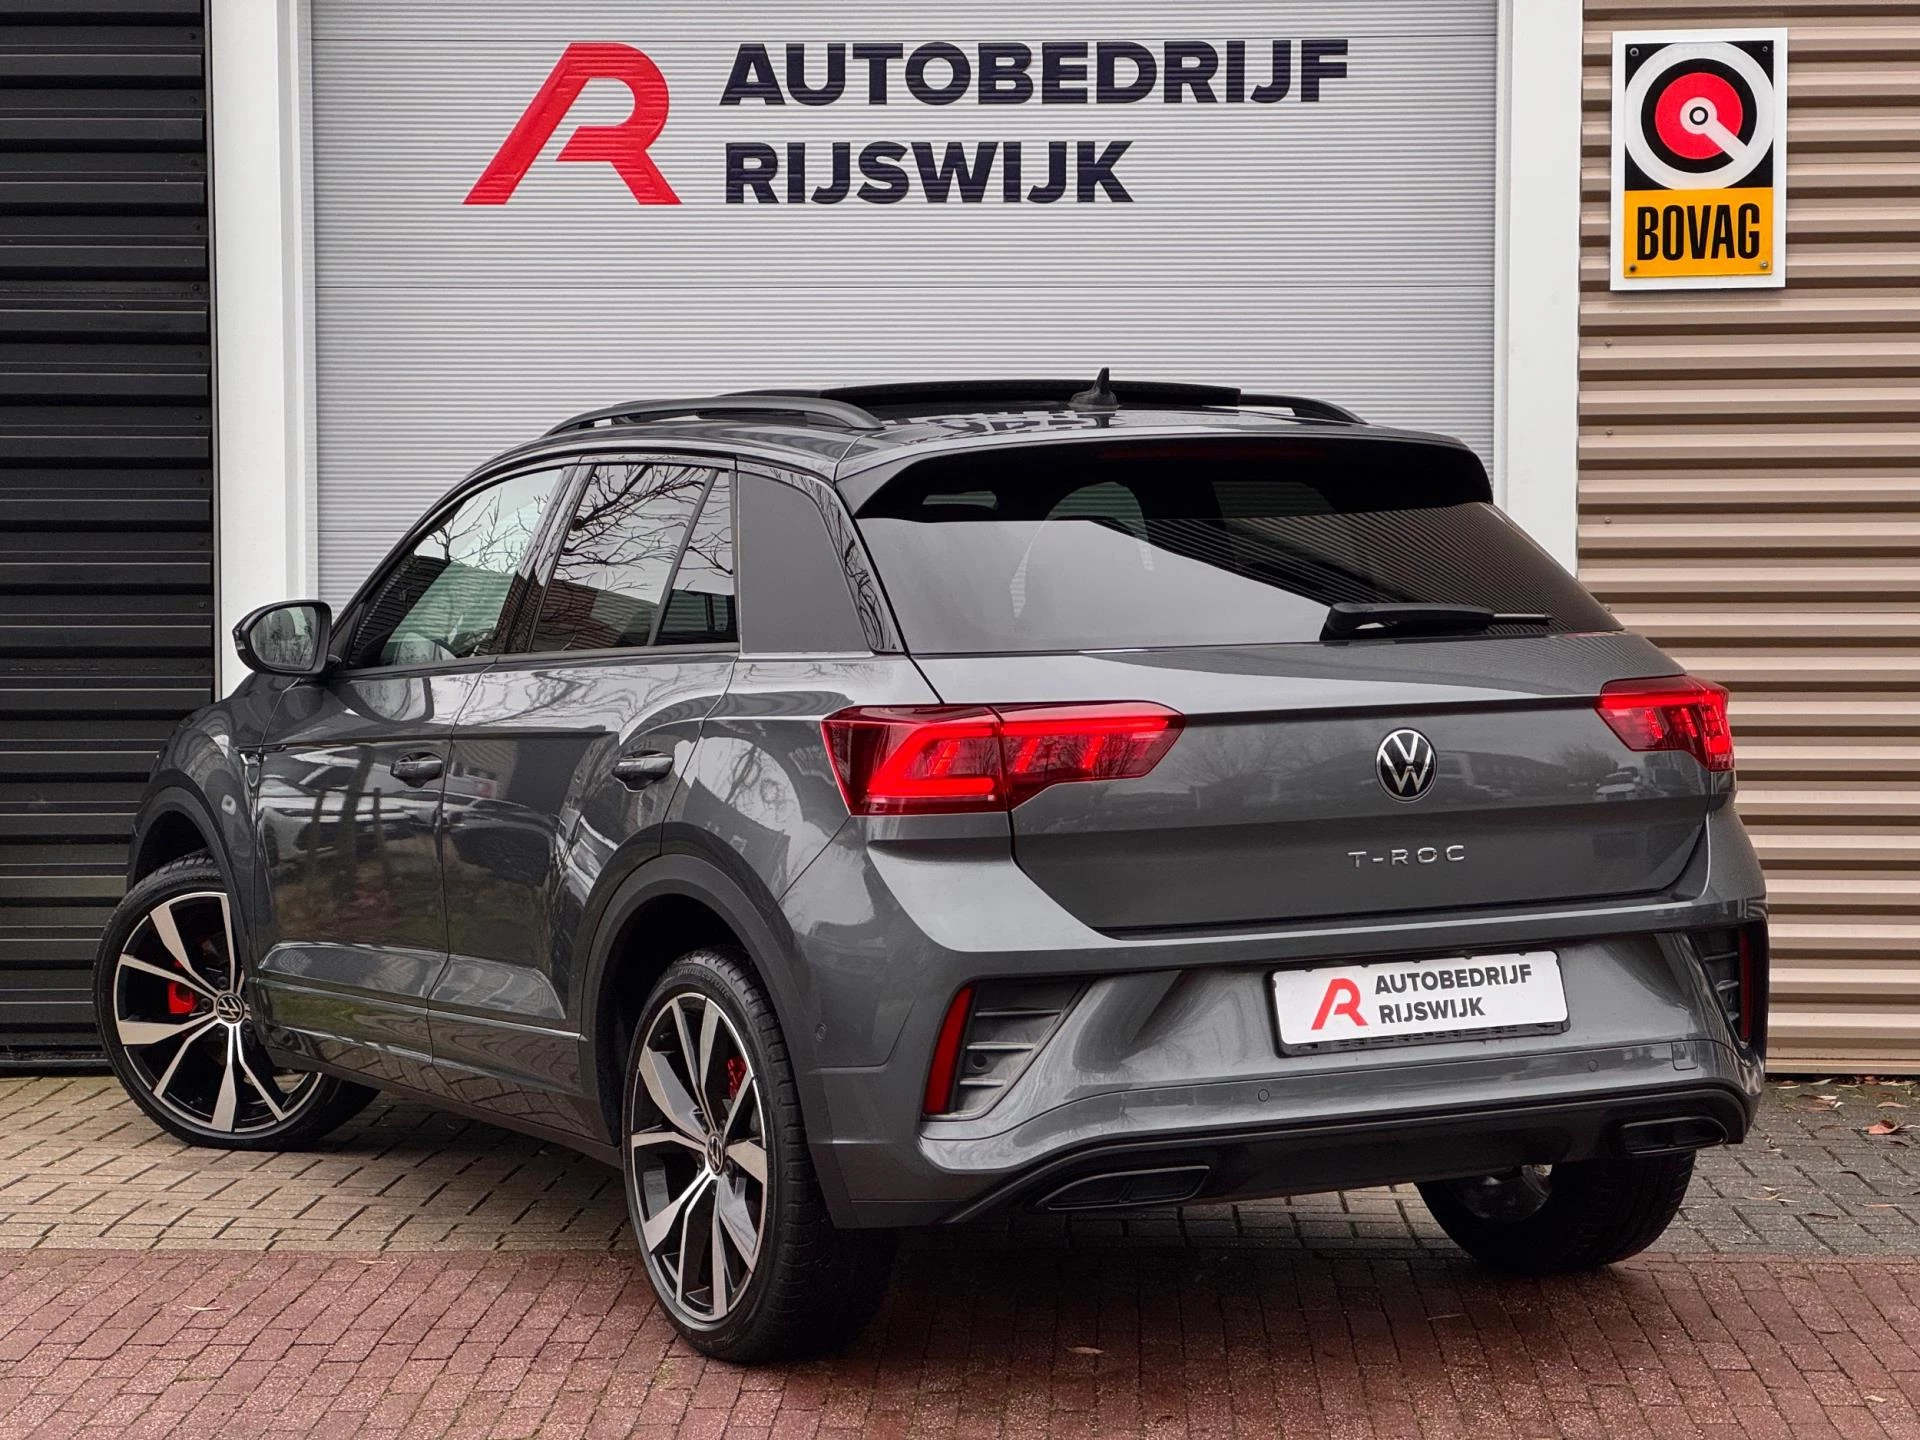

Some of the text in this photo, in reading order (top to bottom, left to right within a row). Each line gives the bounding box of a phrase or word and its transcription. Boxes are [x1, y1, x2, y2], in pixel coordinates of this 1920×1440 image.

[720, 39, 1349, 106] AUTOBEDRIJF
[724, 140, 1134, 205] RIJSWIJK
[1636, 202, 1760, 261] BOVAG
[1347, 844, 1465, 868] T-ROC
[1375, 963, 1532, 995] AUTOBEDRIJF
[1379, 997, 1485, 1024] RIJSWIJK
